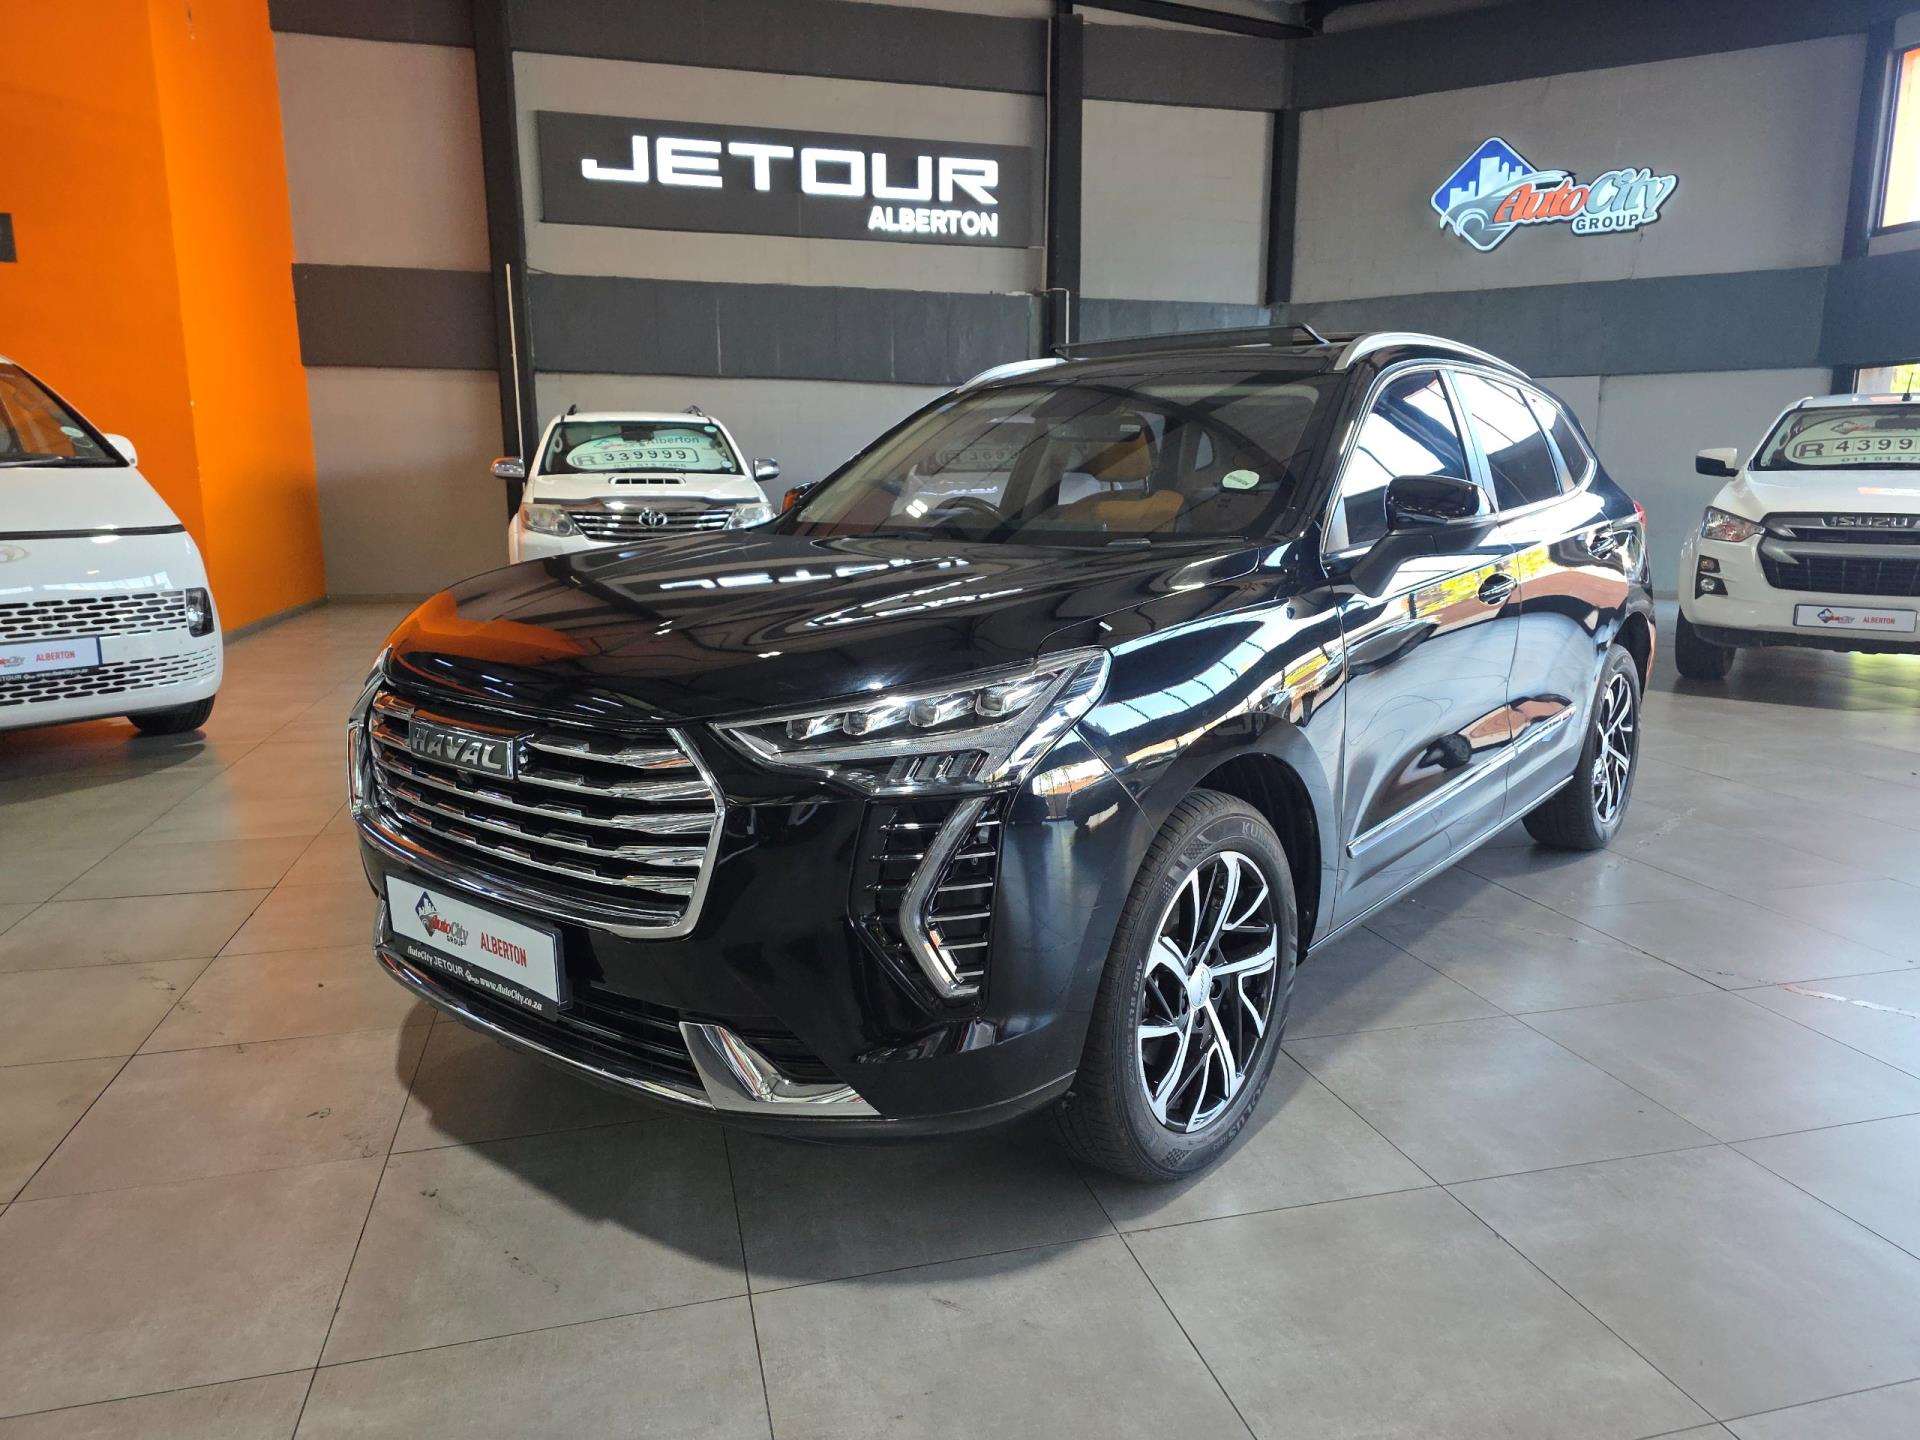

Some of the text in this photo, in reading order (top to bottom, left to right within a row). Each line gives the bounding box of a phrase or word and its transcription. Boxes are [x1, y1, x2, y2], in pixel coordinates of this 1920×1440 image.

[581, 134, 1000, 205] JETOUR
[1493, 169, 1673, 224] AutoCity
[867, 204, 1000, 238] ALBERTON
[1575, 213, 1639, 231] GROUP
[604, 449, 687, 462] 339999
[1831, 516, 1909, 528] ISUZU
[35, 650, 76, 662] ALBERTON
[412, 727, 502, 770] HAVAL
[480, 931, 528, 968] ALBERTON
[433, 954, 465, 977] JETOUR
